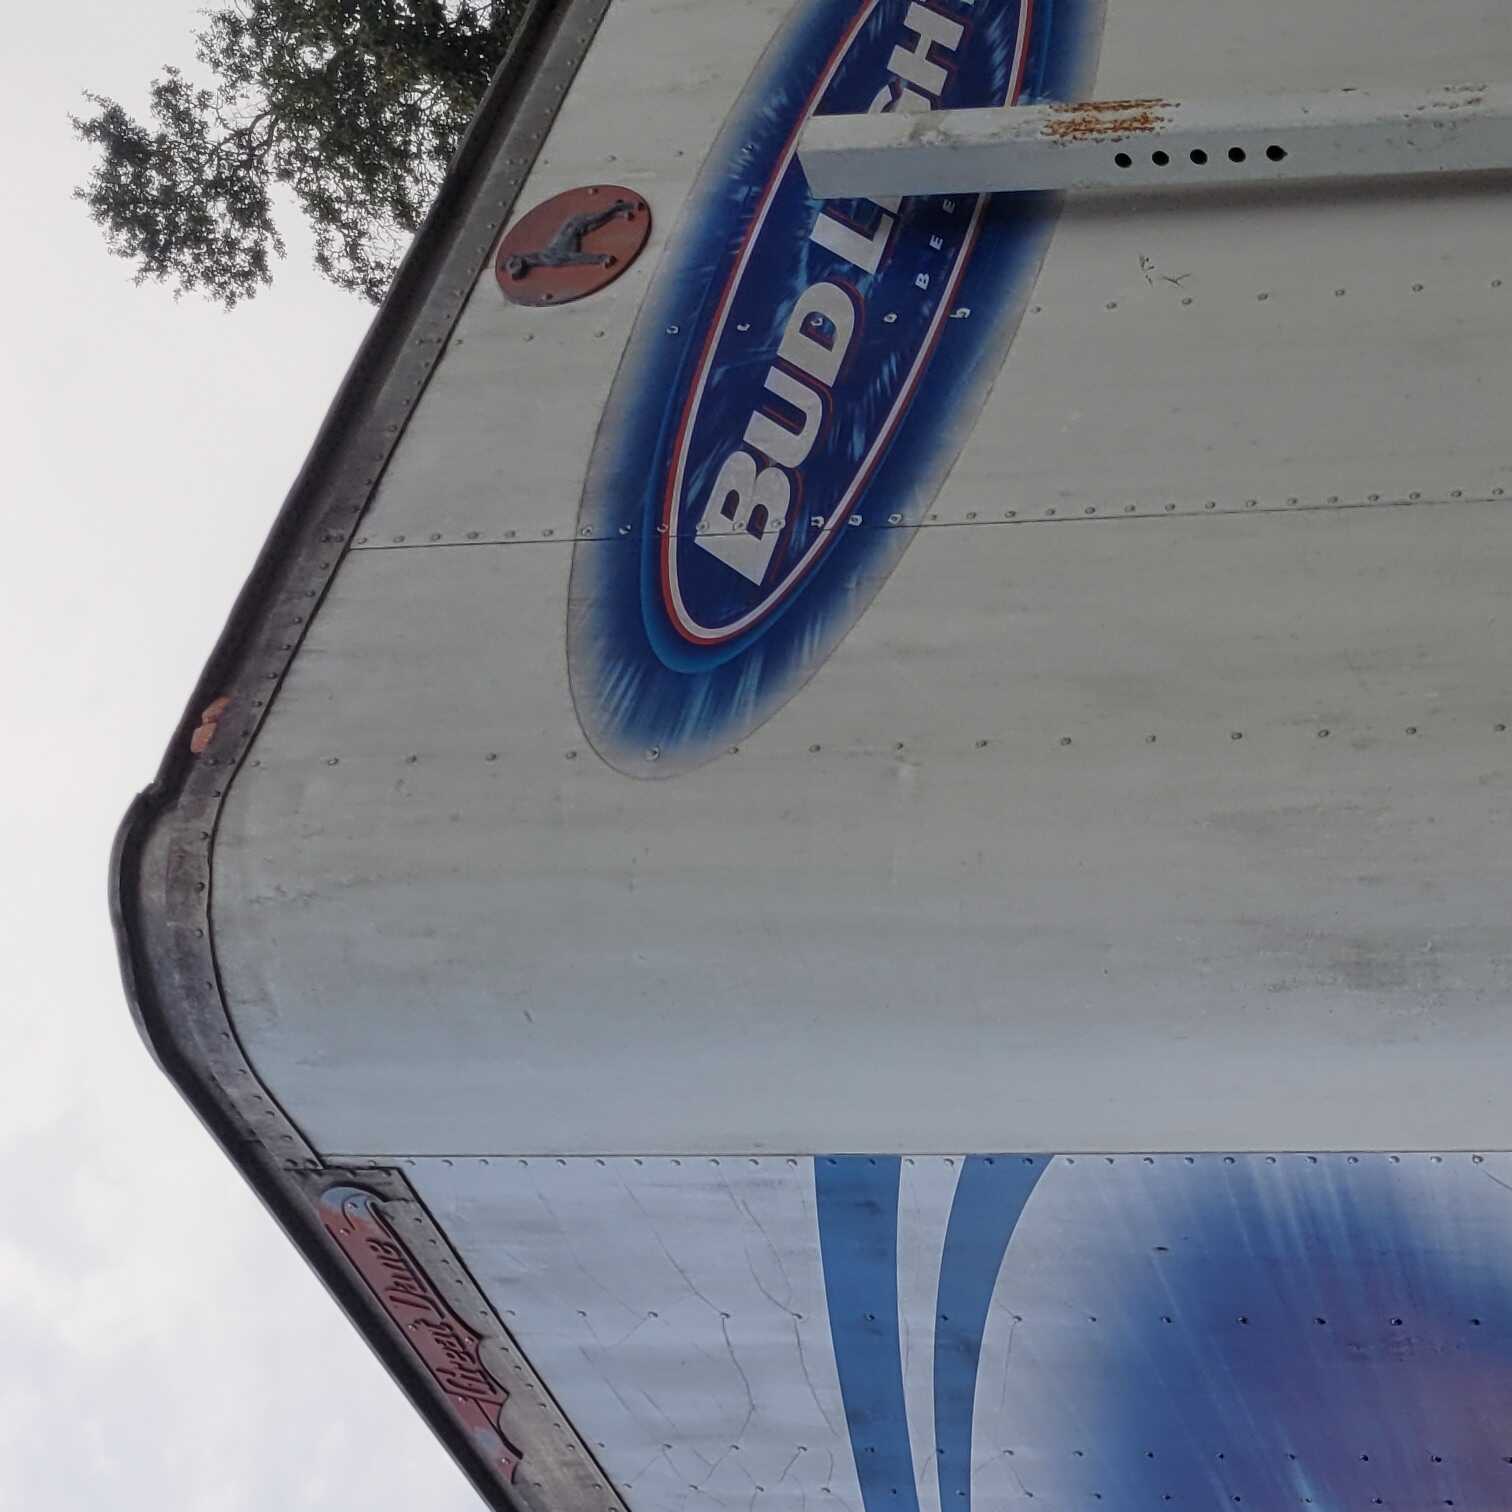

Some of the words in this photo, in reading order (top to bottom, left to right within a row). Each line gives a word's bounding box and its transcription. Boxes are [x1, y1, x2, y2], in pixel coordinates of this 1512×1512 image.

[914, 199, 956, 290] BEE
[694, 281, 856, 586] BUD
[364, 1238, 437, 1313] Dane
[414, 1317, 497, 1402] Great
